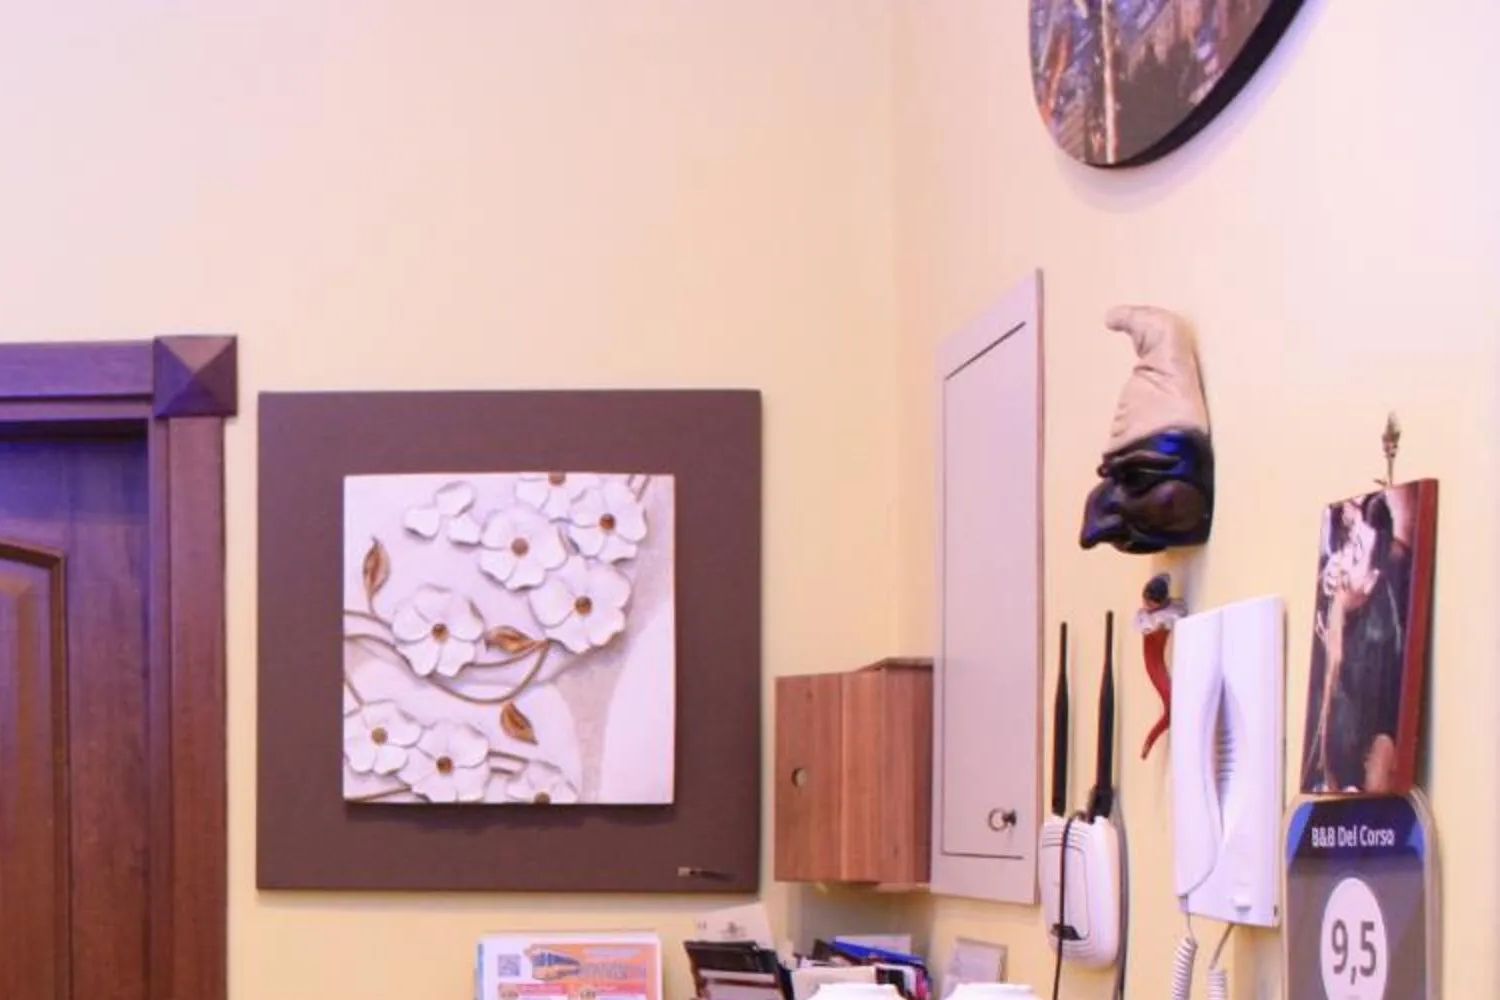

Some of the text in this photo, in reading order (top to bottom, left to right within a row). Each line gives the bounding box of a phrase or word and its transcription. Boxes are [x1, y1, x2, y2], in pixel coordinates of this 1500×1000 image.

[1311, 824, 1395, 848] B&B Del Corso
[1331, 918, 1377, 986] 9,5
